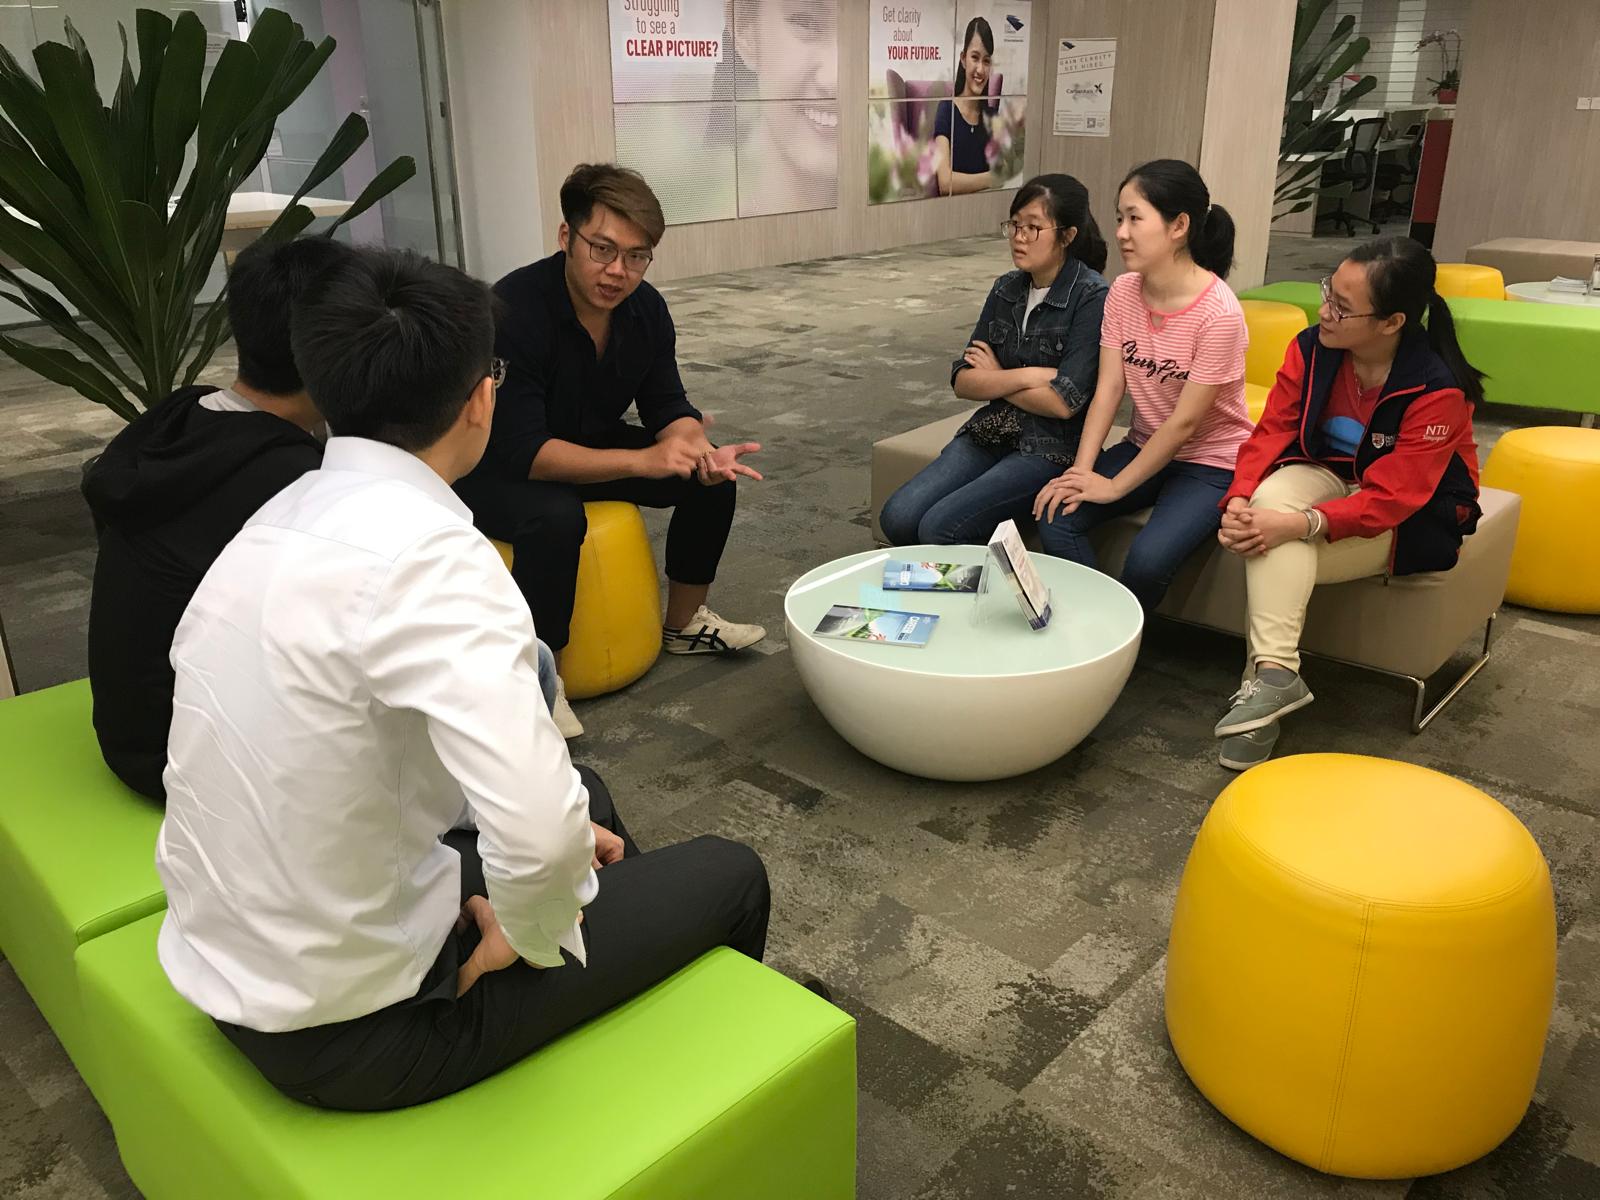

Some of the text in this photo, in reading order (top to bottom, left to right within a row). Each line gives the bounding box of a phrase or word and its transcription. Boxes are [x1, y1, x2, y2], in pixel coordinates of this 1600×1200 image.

[882, 5, 922, 28] Get clarity
[636, 17, 676, 35] to see a
[892, 28, 913, 42] about
[626, 39, 719, 58] CLEAR PICTURE?
[887, 45, 942, 60] YOUR FUTURE.
[1425, 425, 1450, 436] NTU
